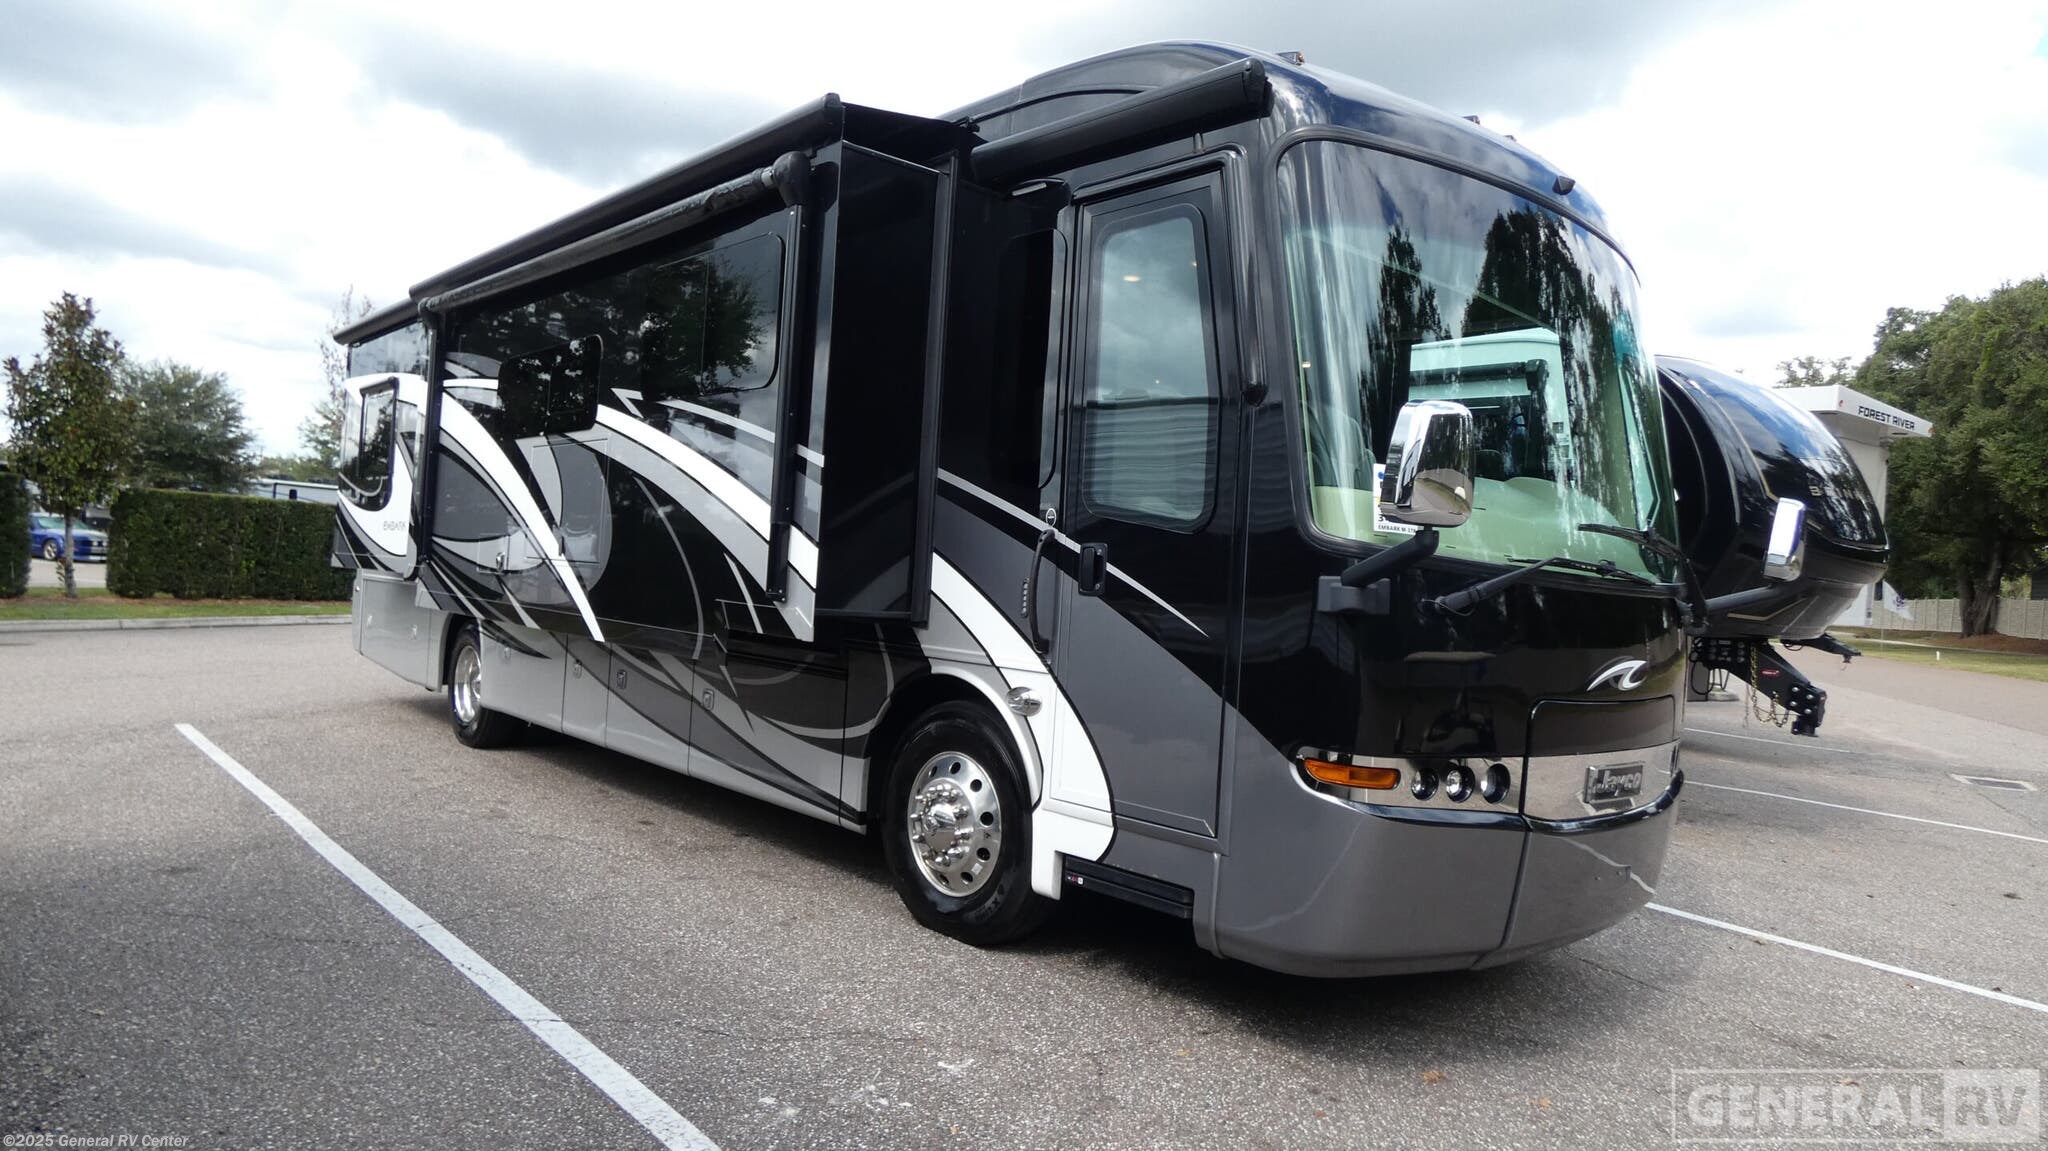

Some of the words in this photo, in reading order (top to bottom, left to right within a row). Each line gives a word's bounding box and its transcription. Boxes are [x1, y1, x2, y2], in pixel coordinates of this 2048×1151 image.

[1858, 405, 1891, 423] FOREST
[1892, 415, 1915, 430] RIVER
[1377, 524, 1400, 532] EMBARK
[1597, 769, 1642, 797] Jayco
